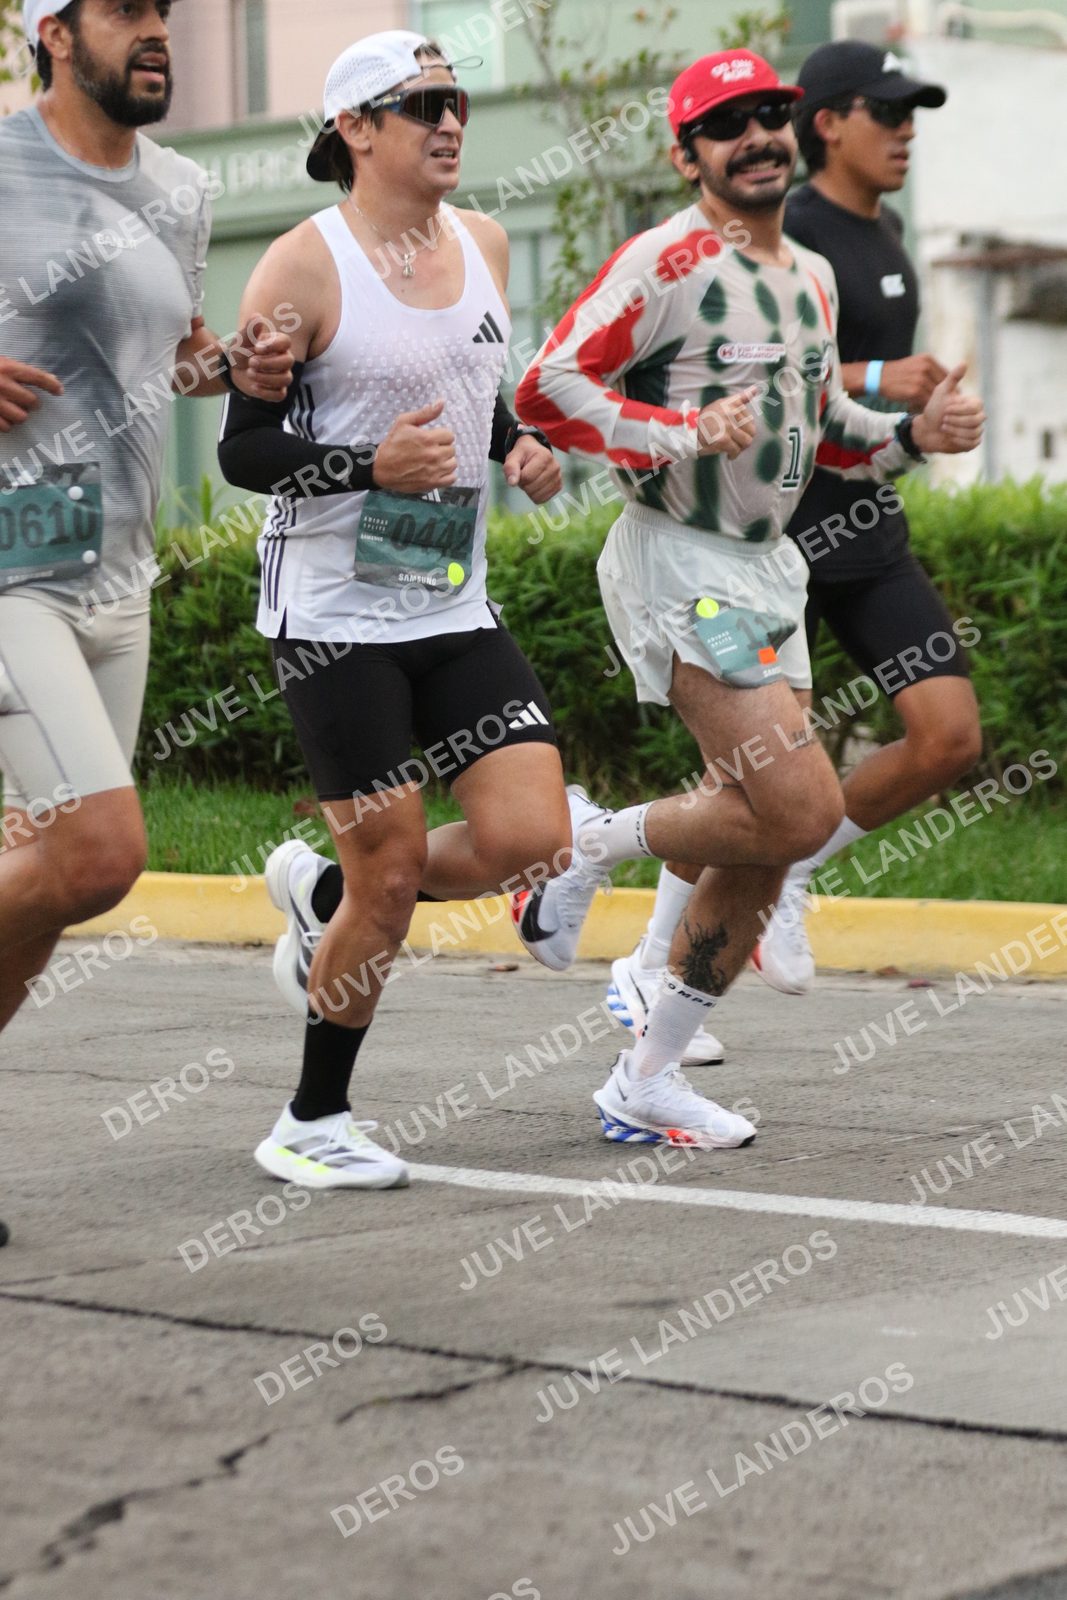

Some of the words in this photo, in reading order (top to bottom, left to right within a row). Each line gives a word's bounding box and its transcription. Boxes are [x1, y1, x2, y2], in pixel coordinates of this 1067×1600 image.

[780, 425, 802, 490] 1
[390, 513, 473, 560] 0442
[398, 573, 437, 586] SAMSUNG
